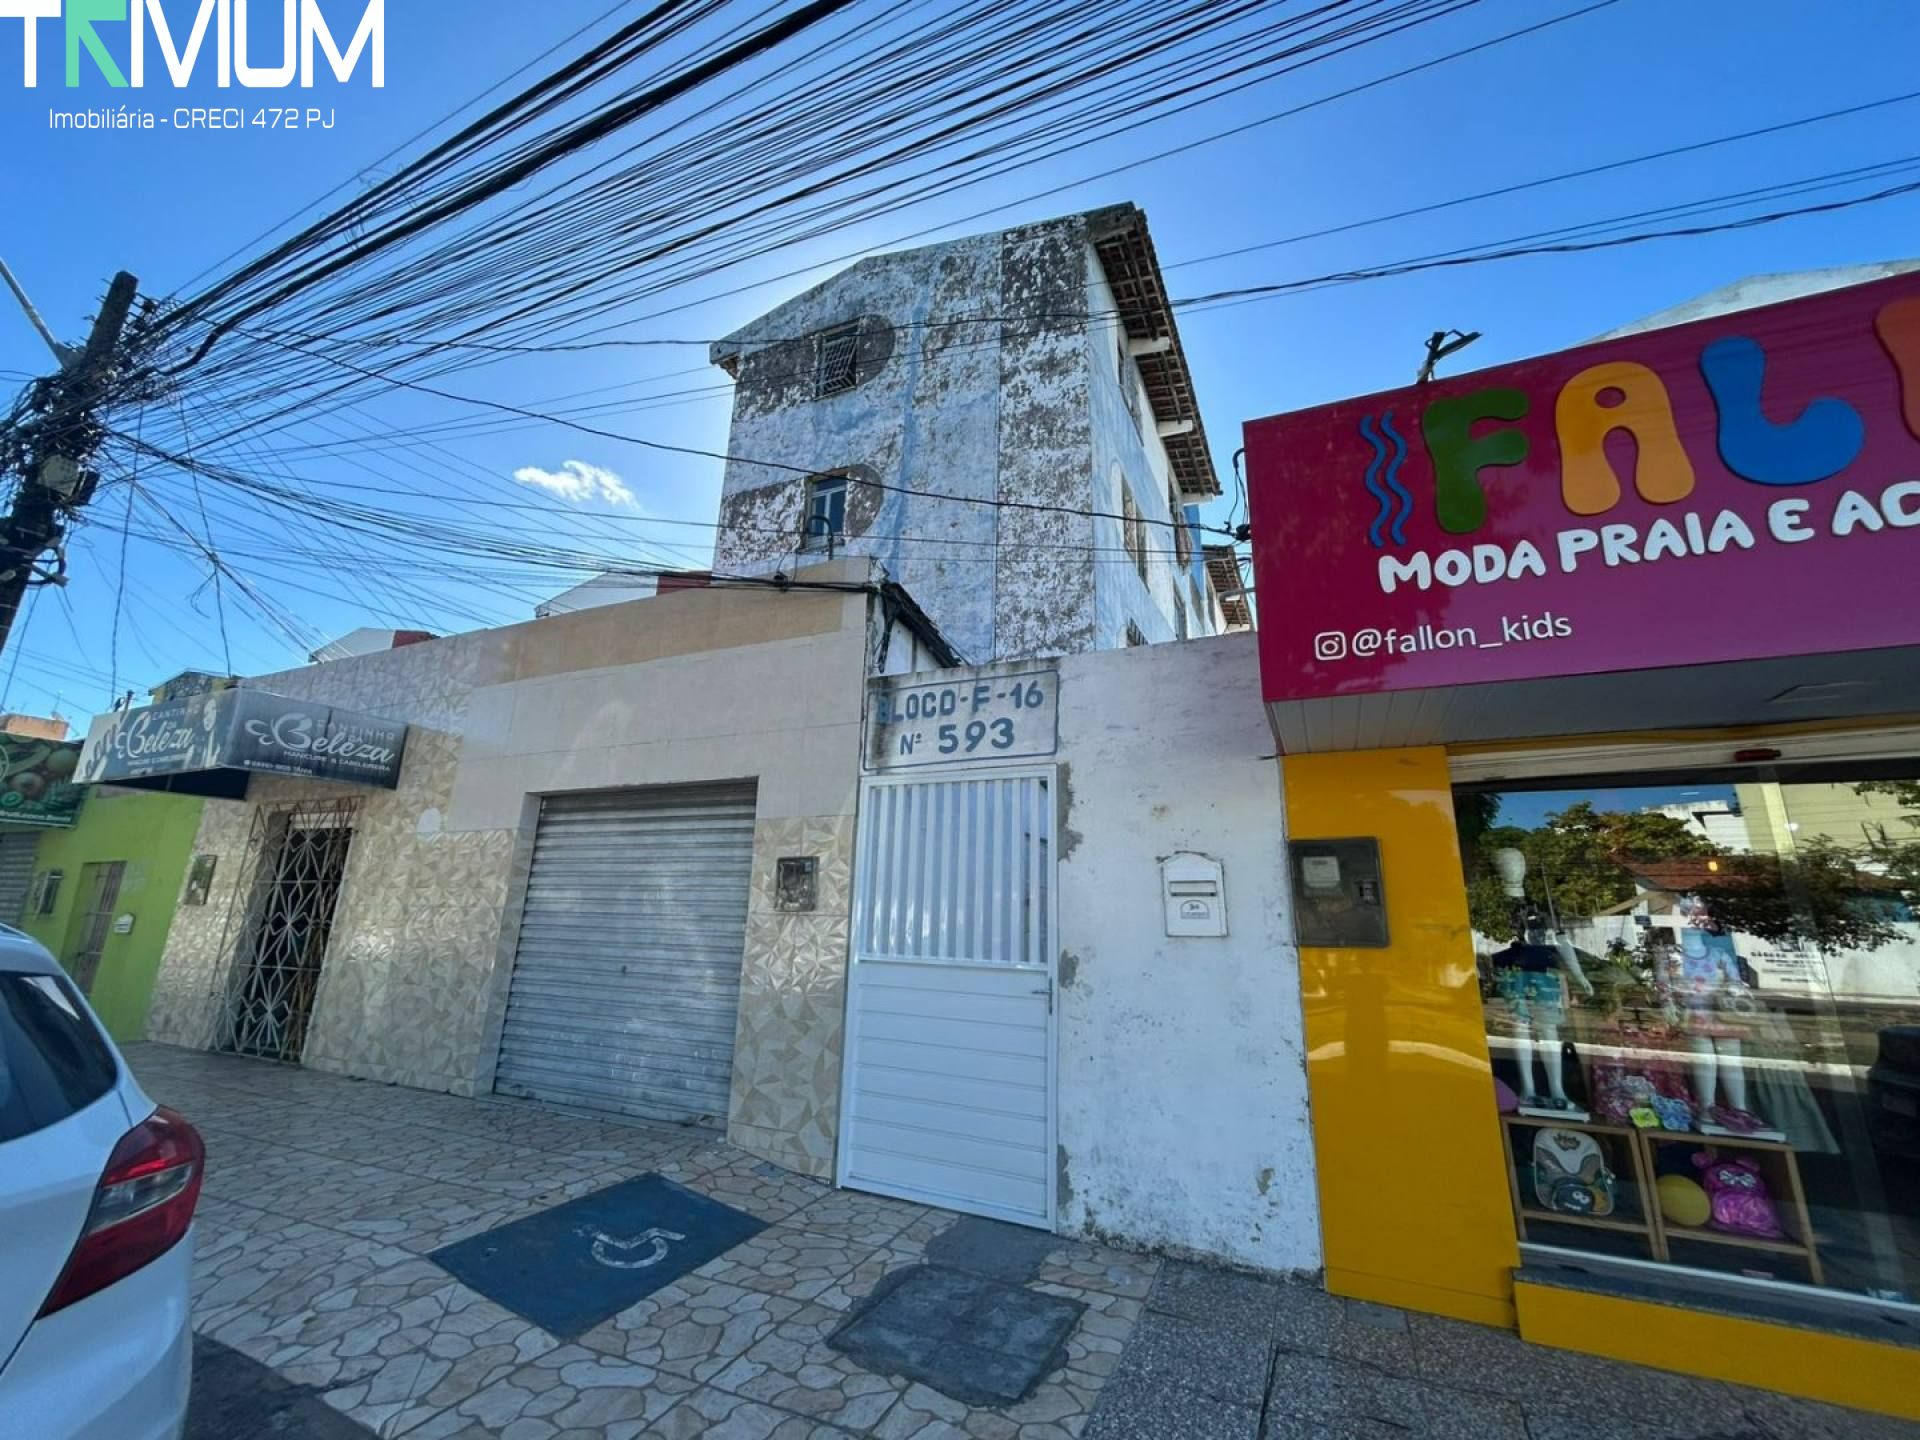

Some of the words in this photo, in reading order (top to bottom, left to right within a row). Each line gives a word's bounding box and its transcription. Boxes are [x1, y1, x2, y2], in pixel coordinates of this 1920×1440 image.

[1422, 295, 1920, 534] FAL
[1378, 540, 1547, 594] MODA
[1557, 510, 1755, 573] PRAIA
[1768, 498, 1815, 543] E
[1351, 611, 1572, 658] @fallon_kids
[271, 712, 395, 763] Beleza
[938, 717, 1015, 754] 593
